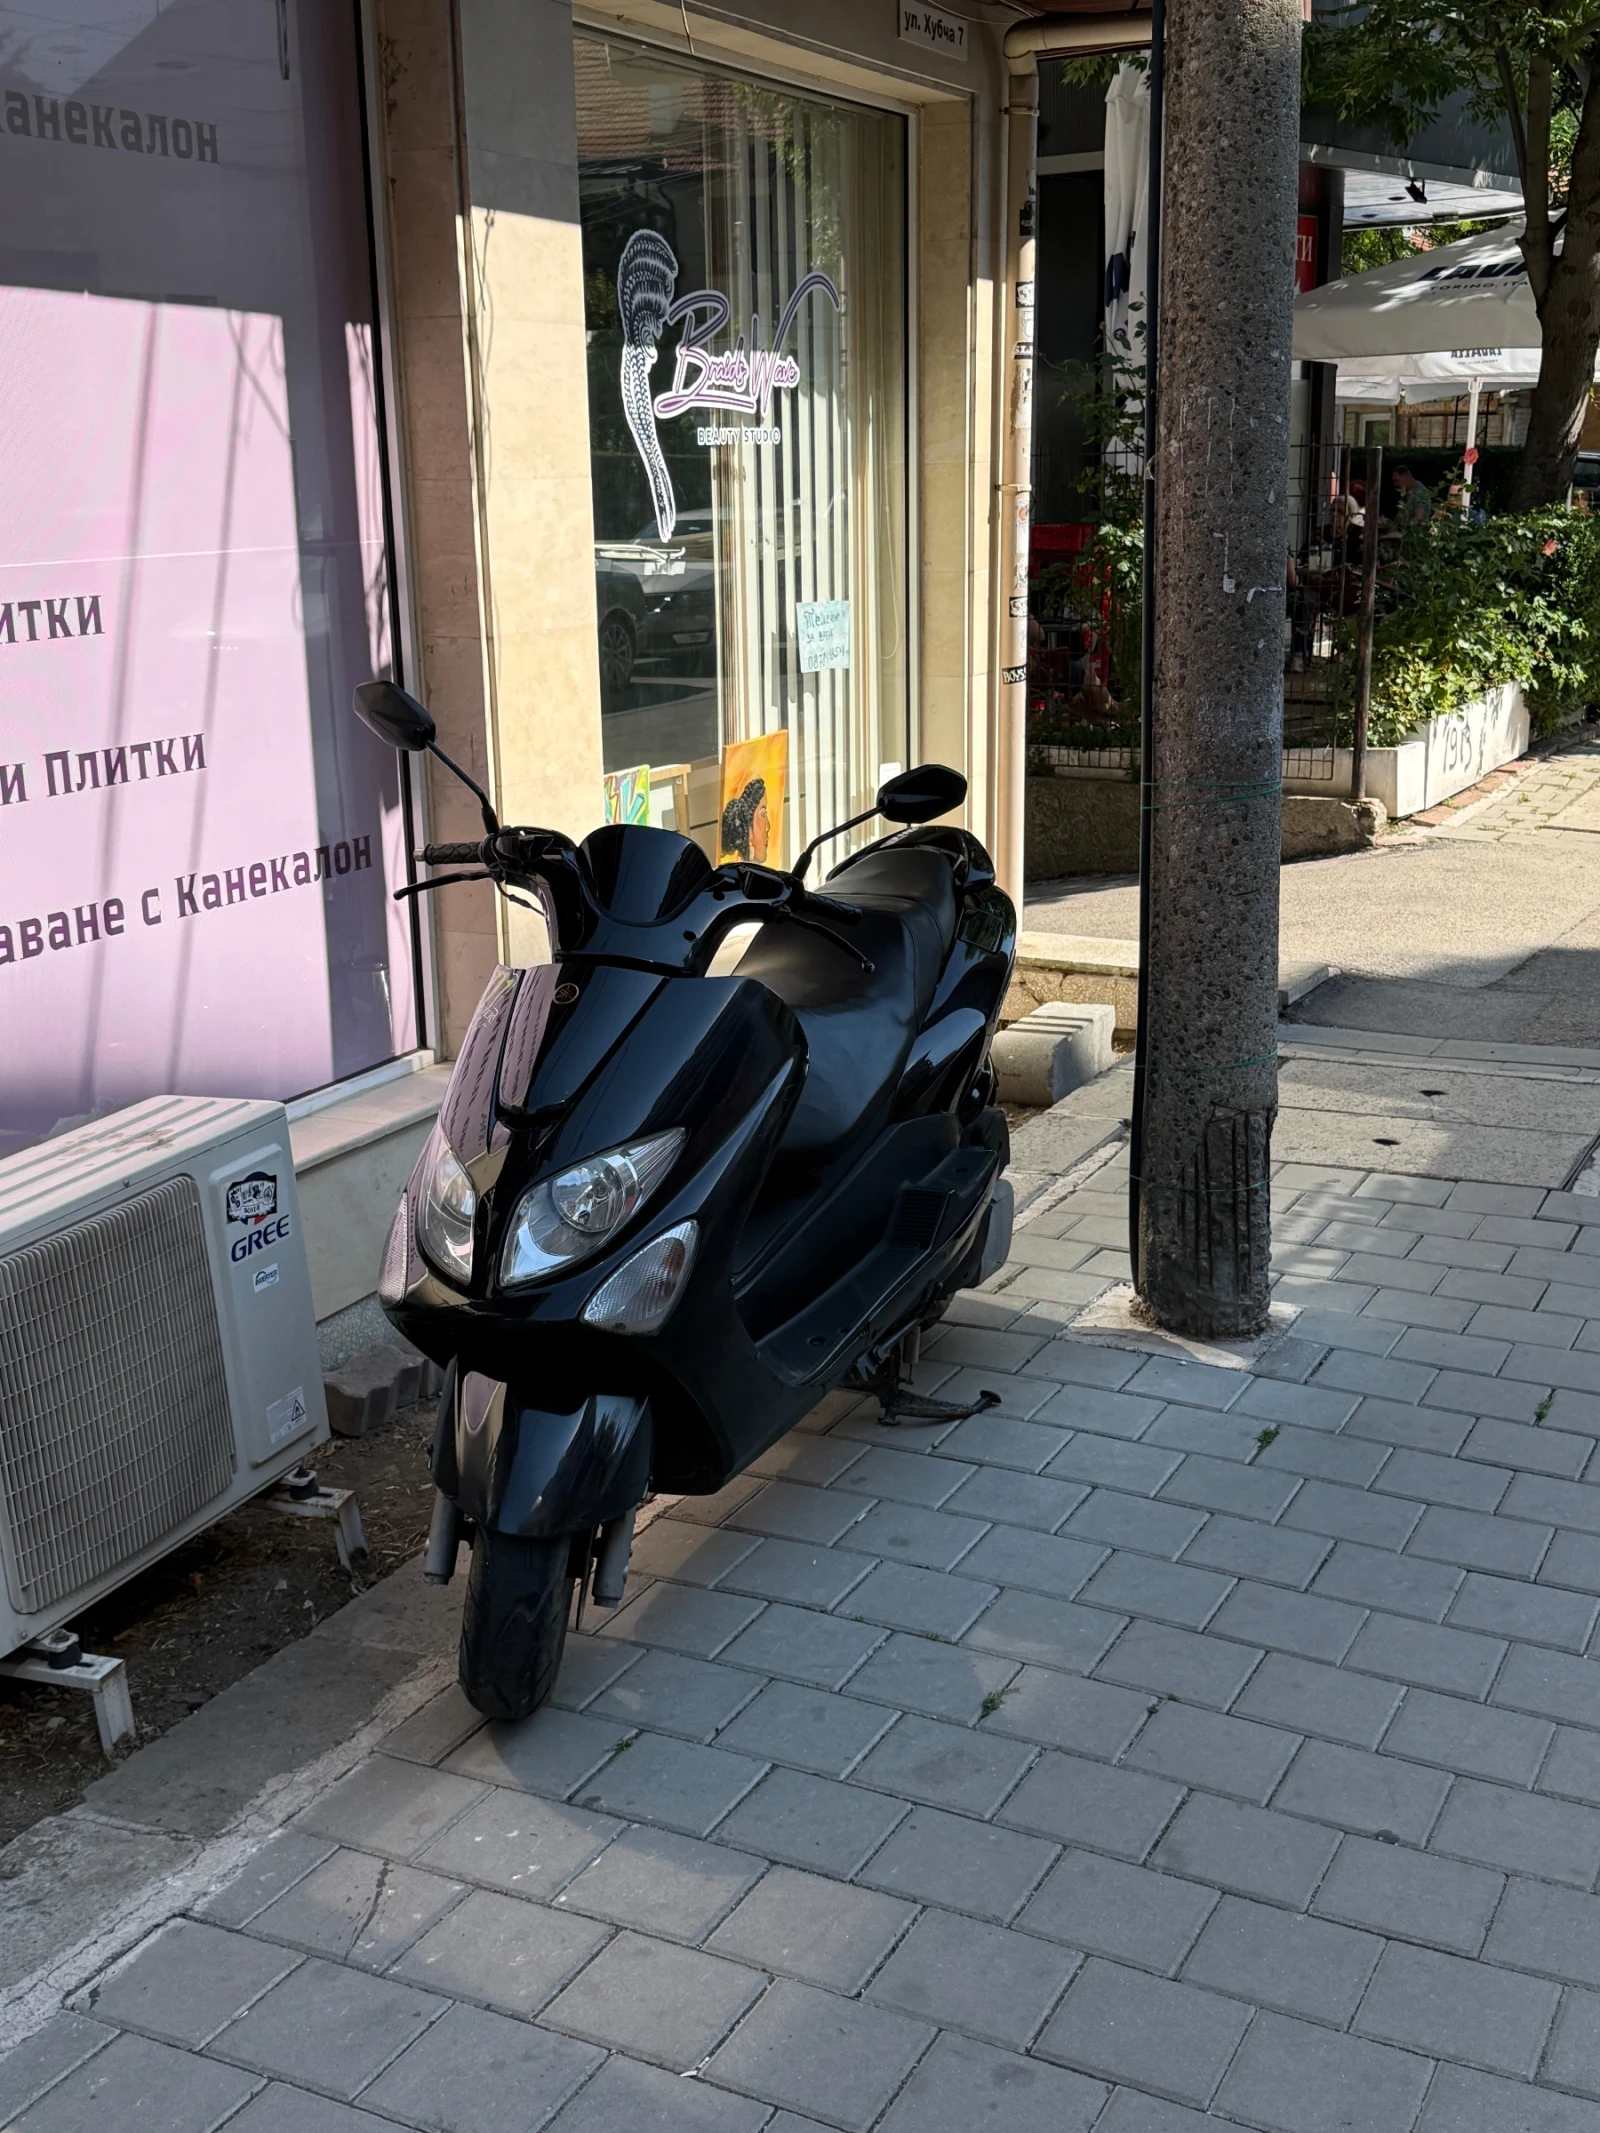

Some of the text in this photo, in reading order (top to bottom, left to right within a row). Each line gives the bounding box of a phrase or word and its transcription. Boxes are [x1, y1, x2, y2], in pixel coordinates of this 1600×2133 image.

[904, 11, 964, 46] ул. Хубча 7
[0, 90, 220, 164] анекалон
[656, 272, 841, 416] Braids Wave
[697, 427, 781, 446] BEAUTY STUDIO
[42, 733, 207, 797] Плитки
[142, 888, 161, 926] с
[174, 834, 373, 918] Канекалон
[231, 1214, 289, 1263] GREE
